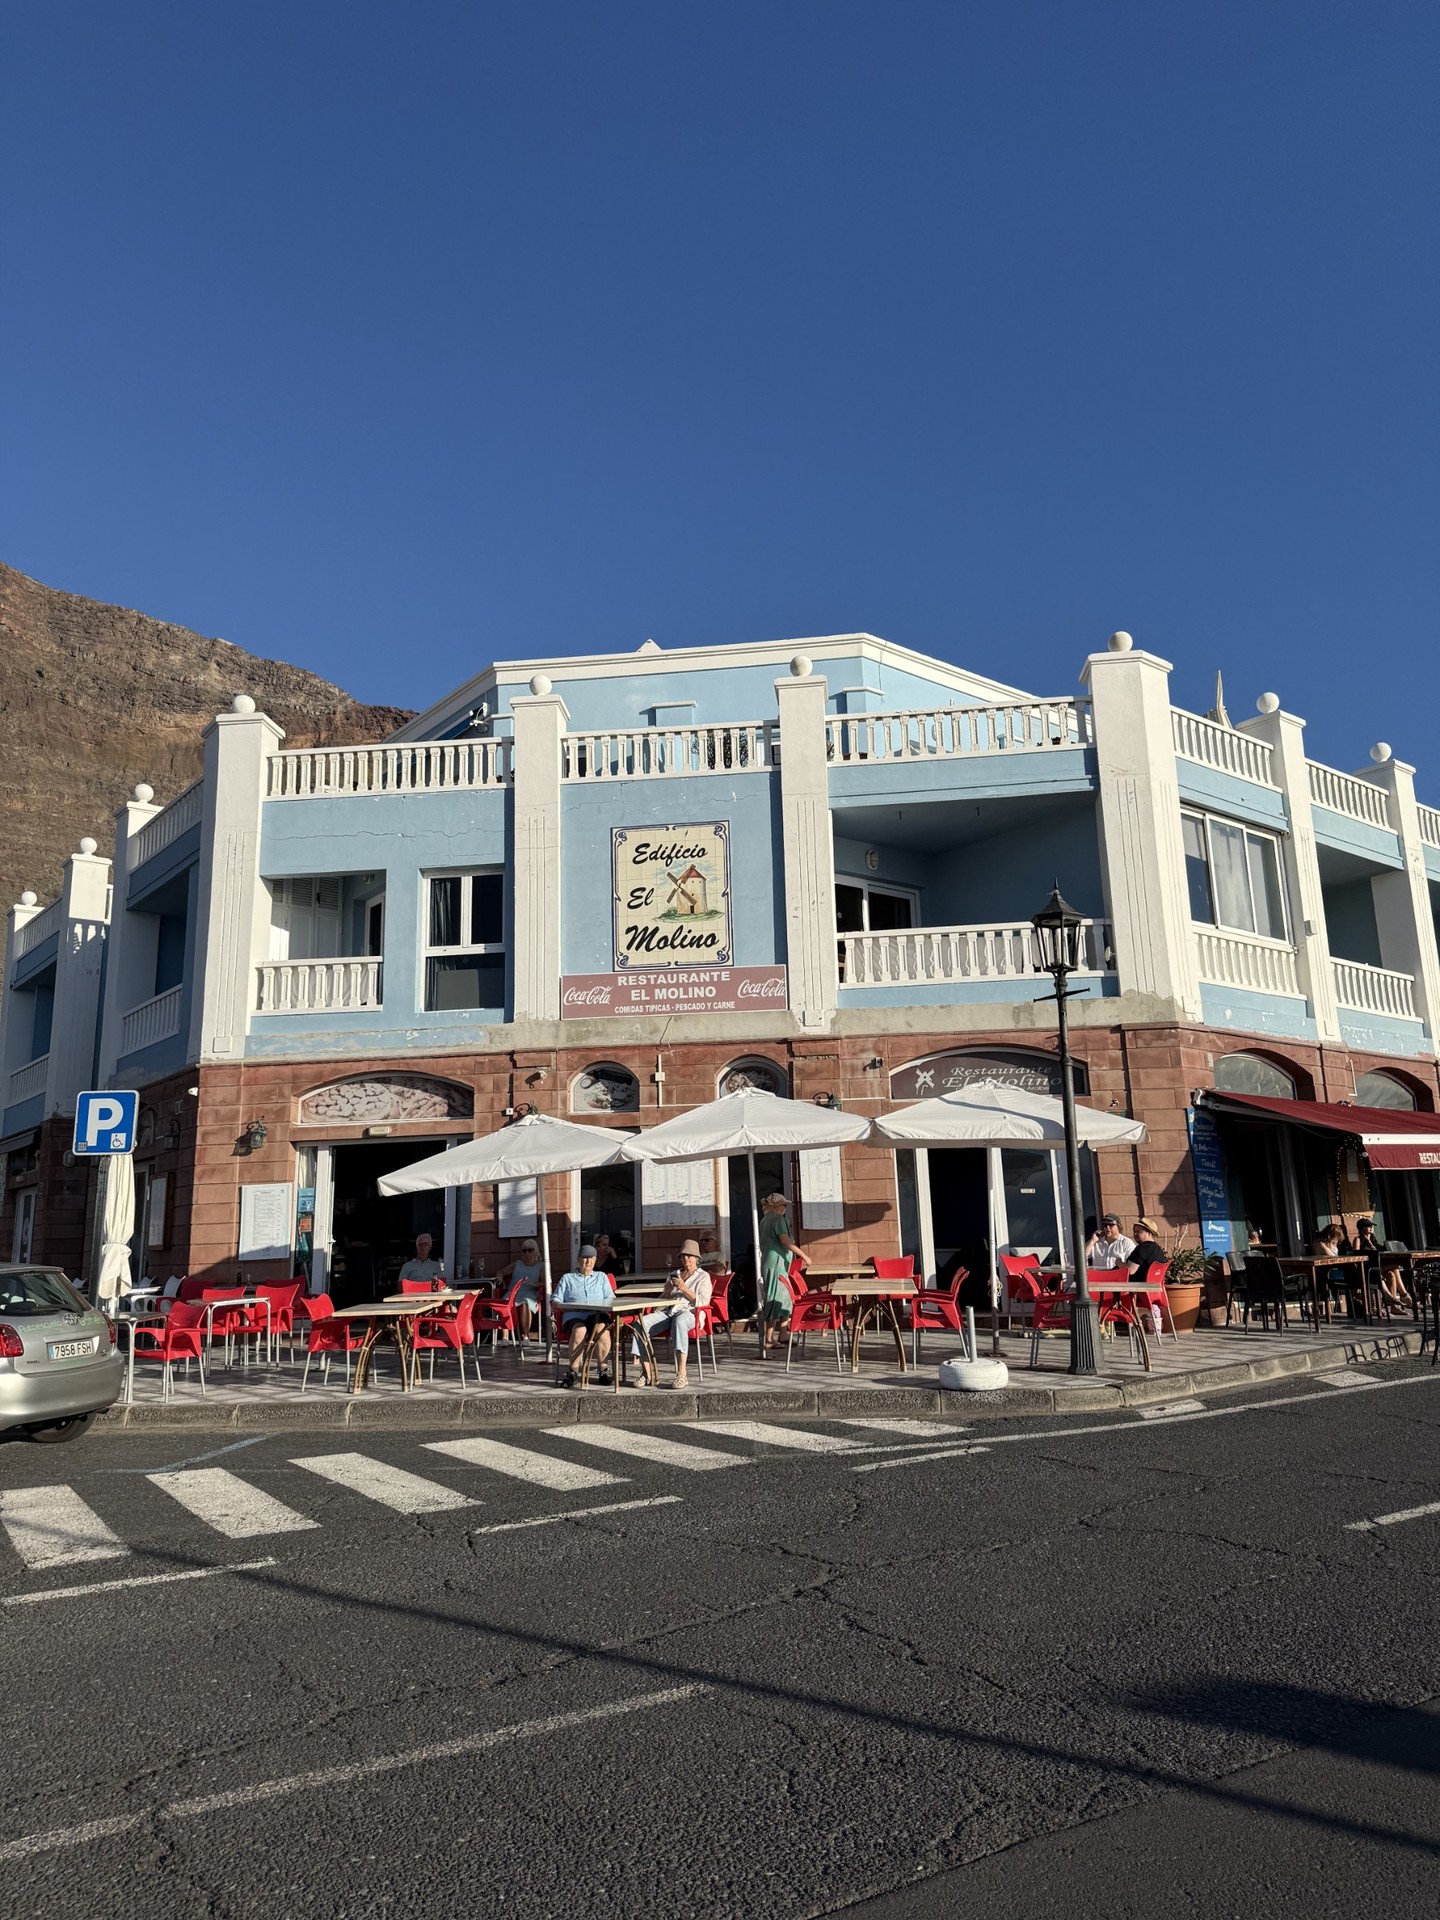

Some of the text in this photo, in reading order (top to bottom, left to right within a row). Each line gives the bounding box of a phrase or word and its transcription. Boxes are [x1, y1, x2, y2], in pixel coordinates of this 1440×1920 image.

[632, 843, 708, 867] Edificio
[627, 887, 655, 909] El
[625, 925, 719, 952] Molino
[617, 971, 730, 986] RESTAURANTE
[737, 977, 785, 998] Coca-Cola
[563, 985, 614, 1006] Coca-Cola
[631, 986, 717, 1001] EL MOLINO
[614, 1001, 736, 1014] COMIDAS TIPICAS PESCADO Y CARNE
[950, 1066, 1052, 1077] Restaurante
[941, 1074, 975, 1088] El
[86, 1098, 124, 1147] P
[54, 1344, 76, 1358] 7958
[77, 1342, 92, 1354] FSH
